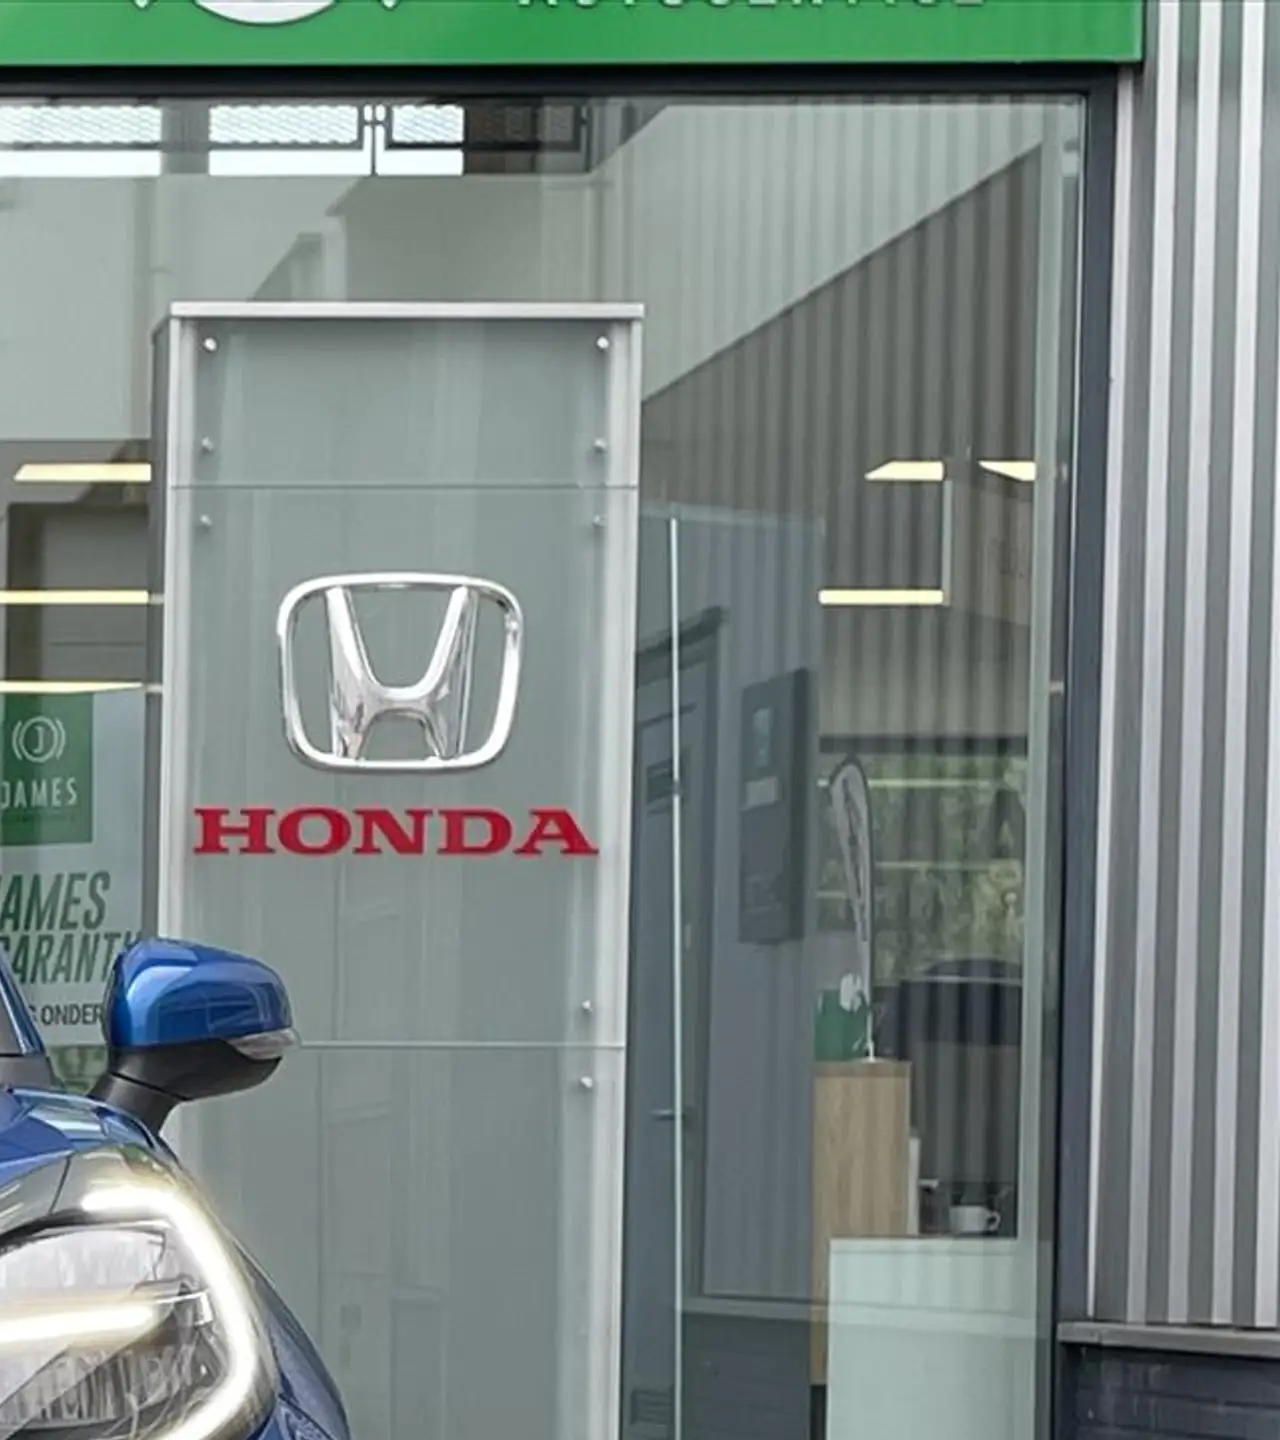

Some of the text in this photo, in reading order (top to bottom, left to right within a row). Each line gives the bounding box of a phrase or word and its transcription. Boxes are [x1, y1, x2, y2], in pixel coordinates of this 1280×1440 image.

[0, 776, 78, 810] JAMES
[192, 807, 600, 856] HONDA
[41, 1003, 105, 1025] ONDER
